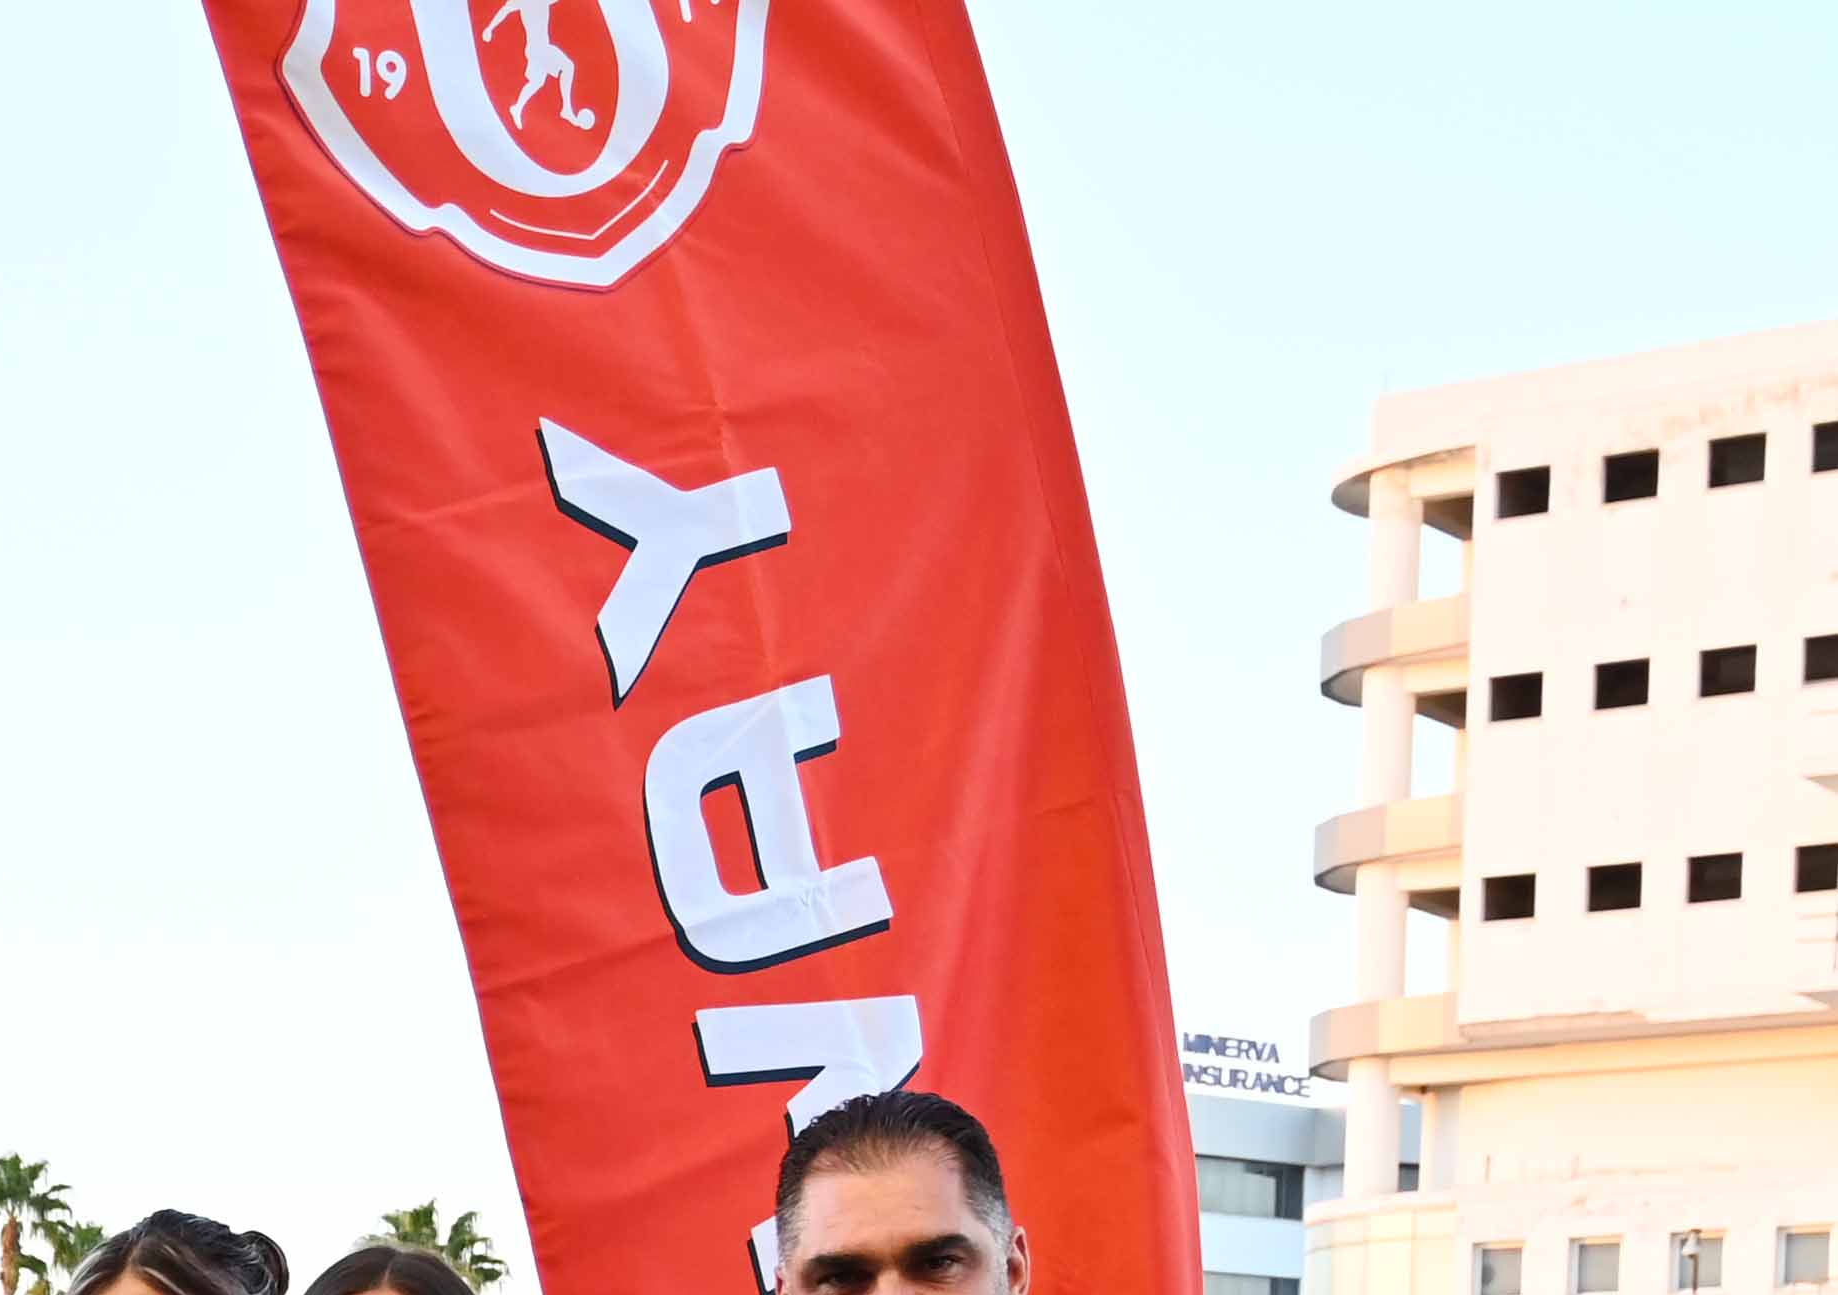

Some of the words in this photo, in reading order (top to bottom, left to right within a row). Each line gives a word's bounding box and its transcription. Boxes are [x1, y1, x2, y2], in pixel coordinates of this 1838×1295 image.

[352, 46, 407, 100] 19
[1183, 1032, 1280, 1063] MINERVA
[1183, 1063, 1311, 1098] INSURANCE
